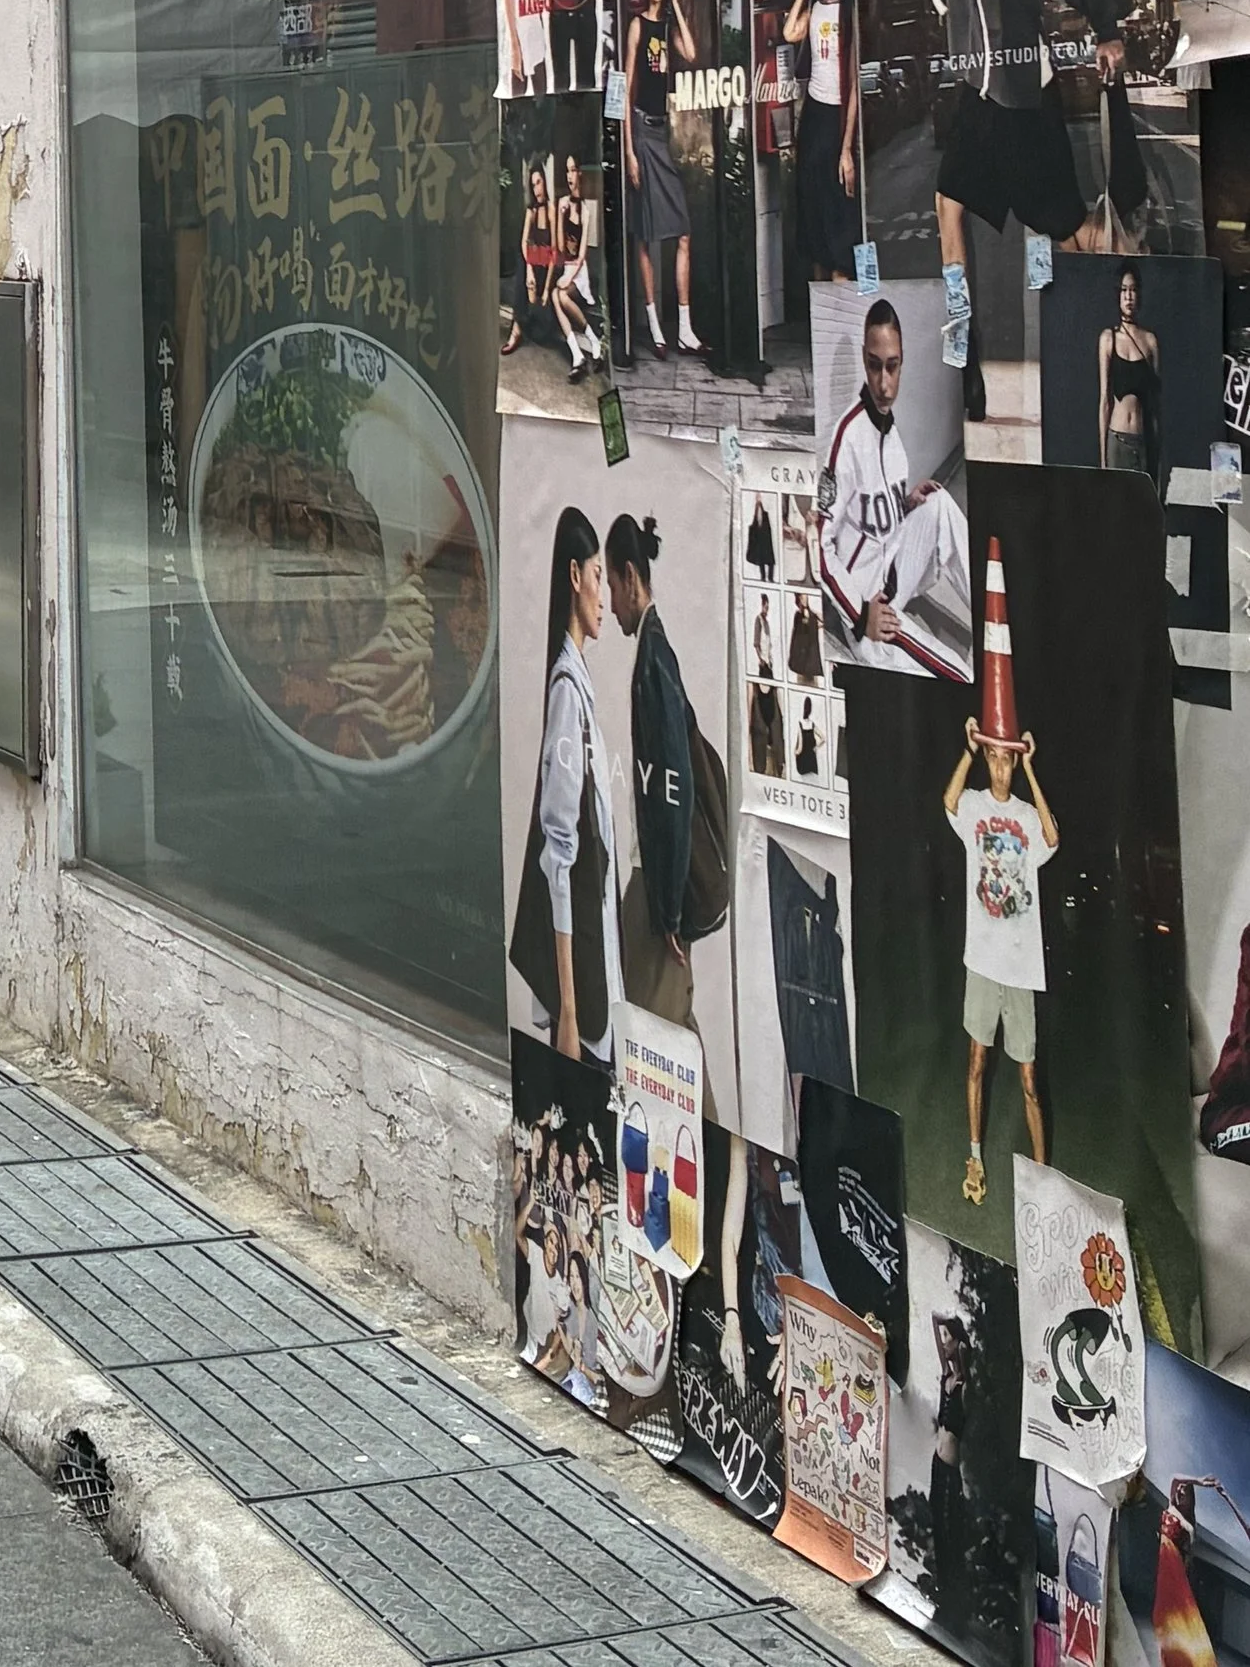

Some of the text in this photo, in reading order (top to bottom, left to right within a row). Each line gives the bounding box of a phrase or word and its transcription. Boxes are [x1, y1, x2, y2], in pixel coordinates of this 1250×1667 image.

[675, 65, 746, 112] MARGO
[556, 736, 681, 806] GRAYE
[763, 786, 795, 807] VEST
[800, 794, 833, 817] TOTE
[625, 1038, 639, 1059] THE
[625, 1066, 638, 1086] THE
[641, 1073, 675, 1103] EVERYDAY
[788, 1309, 817, 1344] Why
[859, 1444, 881, 1474] Not
